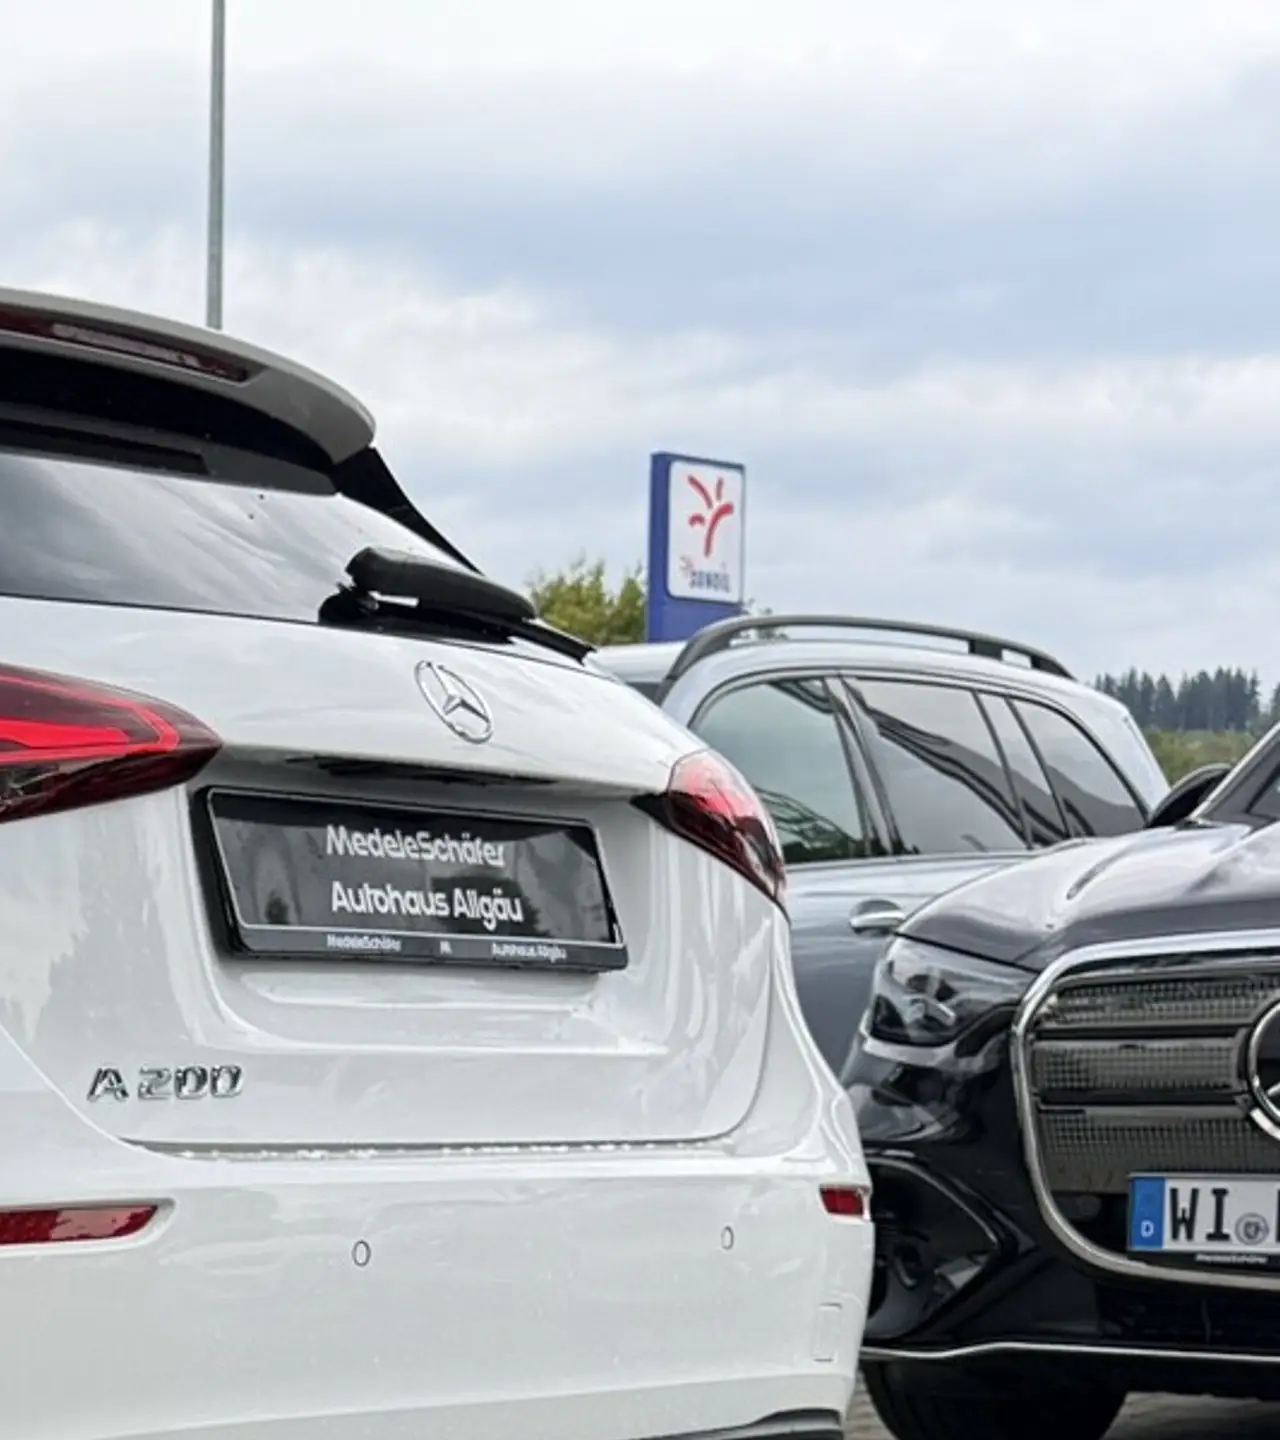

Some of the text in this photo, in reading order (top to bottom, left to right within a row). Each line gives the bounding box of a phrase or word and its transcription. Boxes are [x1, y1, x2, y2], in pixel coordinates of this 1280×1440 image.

[327, 825, 505, 867] MedeleSchäfer
[332, 881, 523, 931] Autohaus Allgäu
[87, 1065, 243, 1102] A 200
[1141, 1220, 1154, 1237] D
[1169, 1187, 1230, 1242] WI
